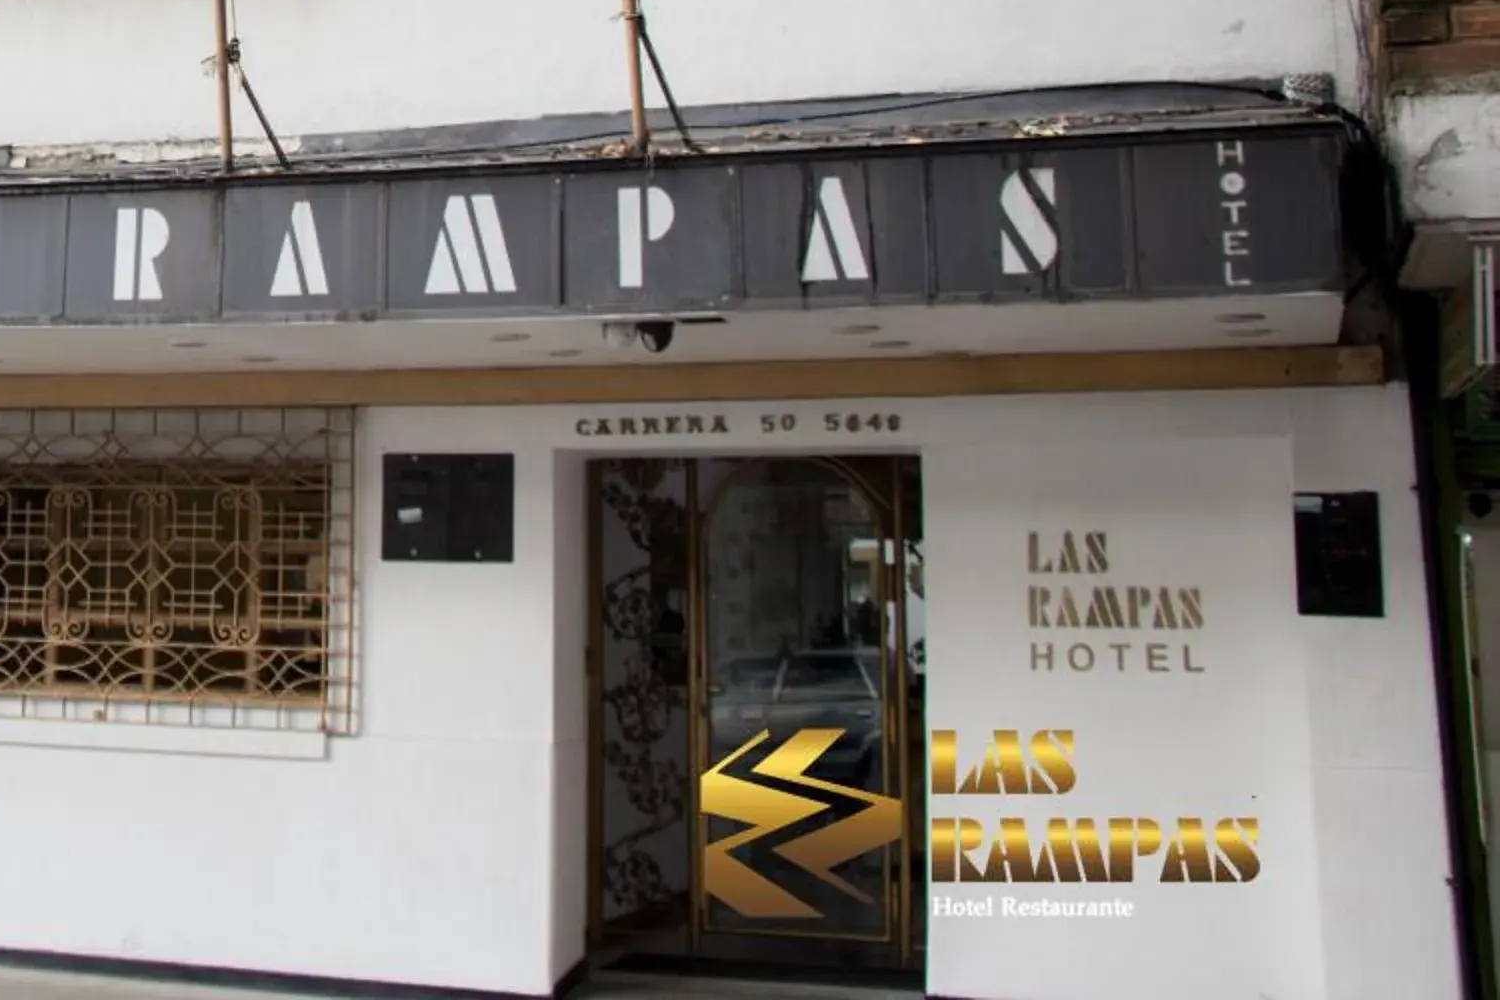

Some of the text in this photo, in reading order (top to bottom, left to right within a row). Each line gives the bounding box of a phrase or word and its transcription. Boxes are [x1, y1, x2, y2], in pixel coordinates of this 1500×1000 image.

[112, 167, 1059, 300] RAMPAS
[1216, 141, 1252, 287] HOTEL
[575, 414, 730, 436] CARRERA
[760, 413, 797, 434] 50
[1027, 529, 1109, 574] LAS
[1028, 584, 1204, 630] RAMPAS
[1029, 642, 1205, 672] HOTEL
